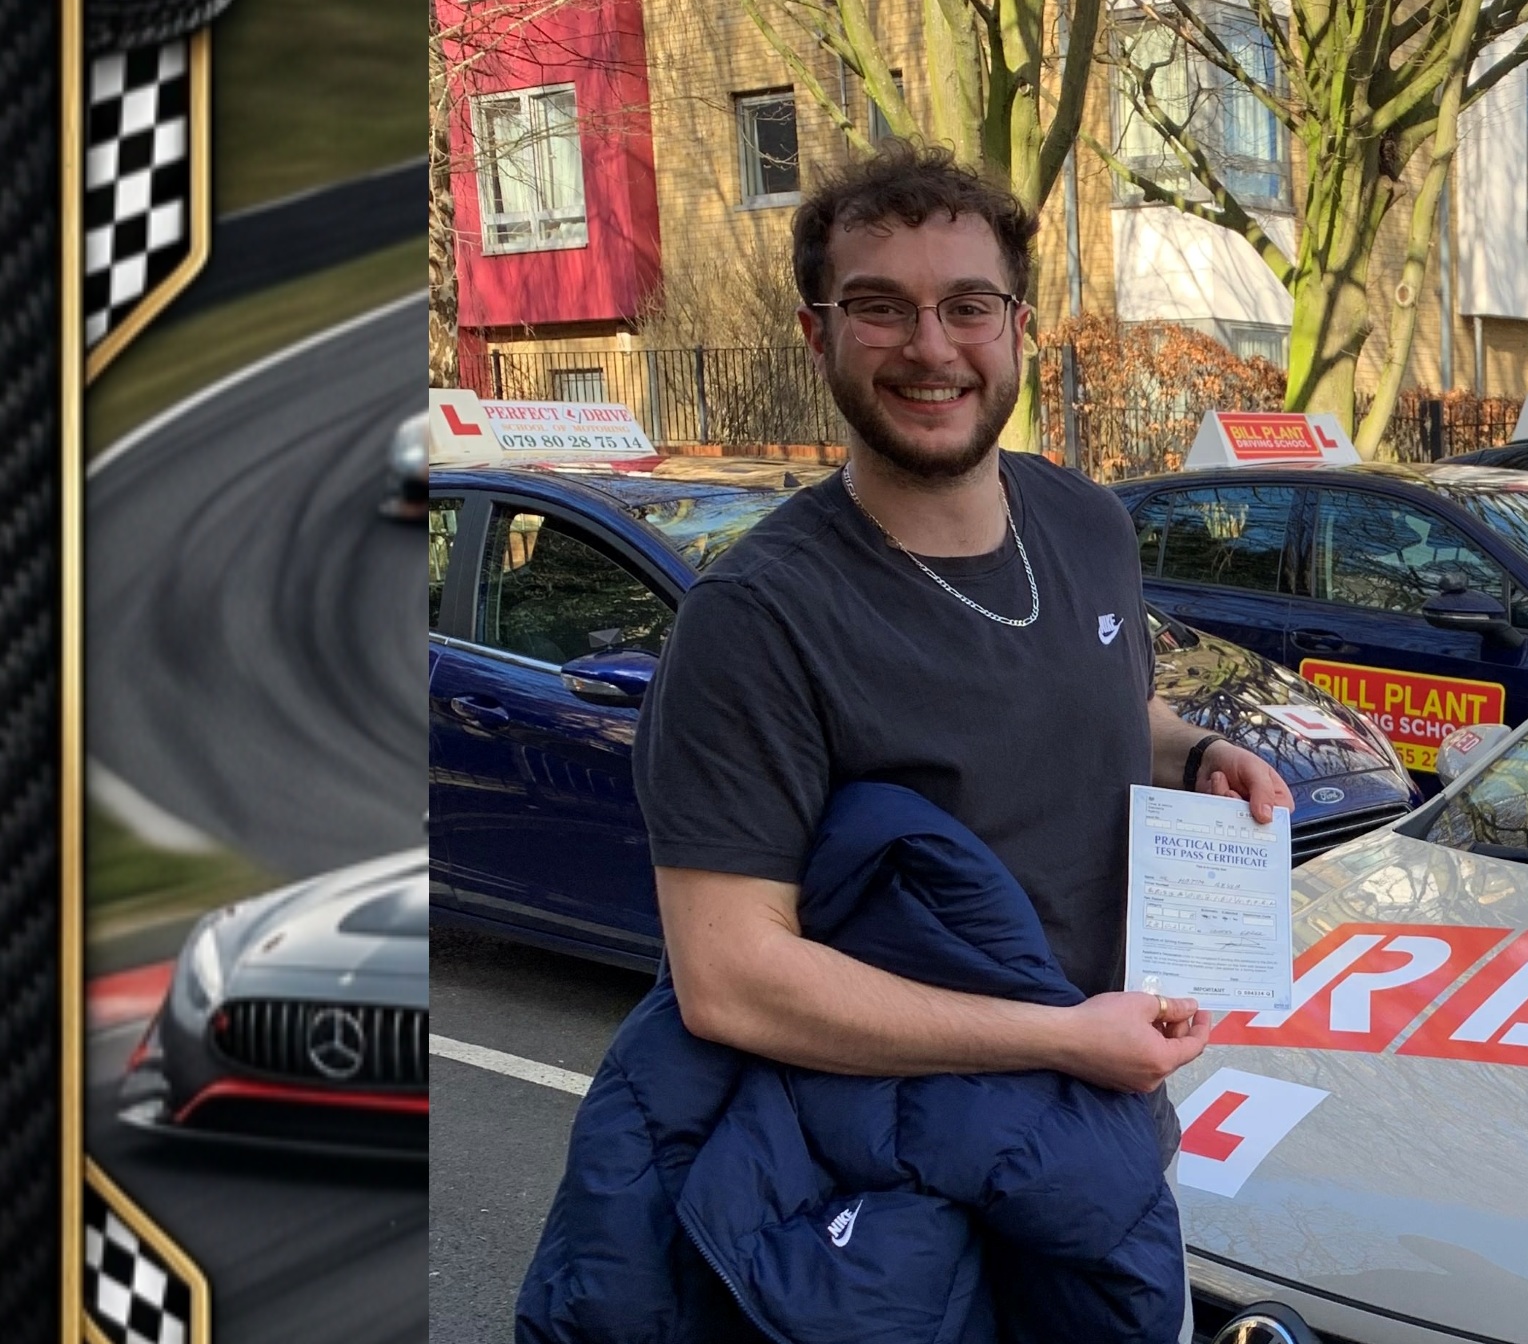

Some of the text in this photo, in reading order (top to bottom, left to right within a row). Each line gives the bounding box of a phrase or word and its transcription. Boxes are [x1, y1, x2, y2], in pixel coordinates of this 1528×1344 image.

[440, 404, 482, 436] L
[484, 405, 561, 420] PERFECT
[583, 408, 632, 422] DRIVE
[501, 423, 630, 433] SCHOOL OF MOTORING
[1229, 426, 1304, 440] BILL PLANT
[1314, 425, 1338, 448] L
[502, 434, 643, 449] 079 80 28 75 14
[1236, 440, 1311, 448] DRIVING SCHOOL
[1384, 682, 1487, 724] PLANT
[1283, 712, 1329, 730] L
[1154, 834, 1268, 857] PRACTICAL DRIVING
[1155, 846, 1177, 857] TEST
[1180, 849, 1204, 860] PASS
[1206, 852, 1268, 868] CERTIFICATE
